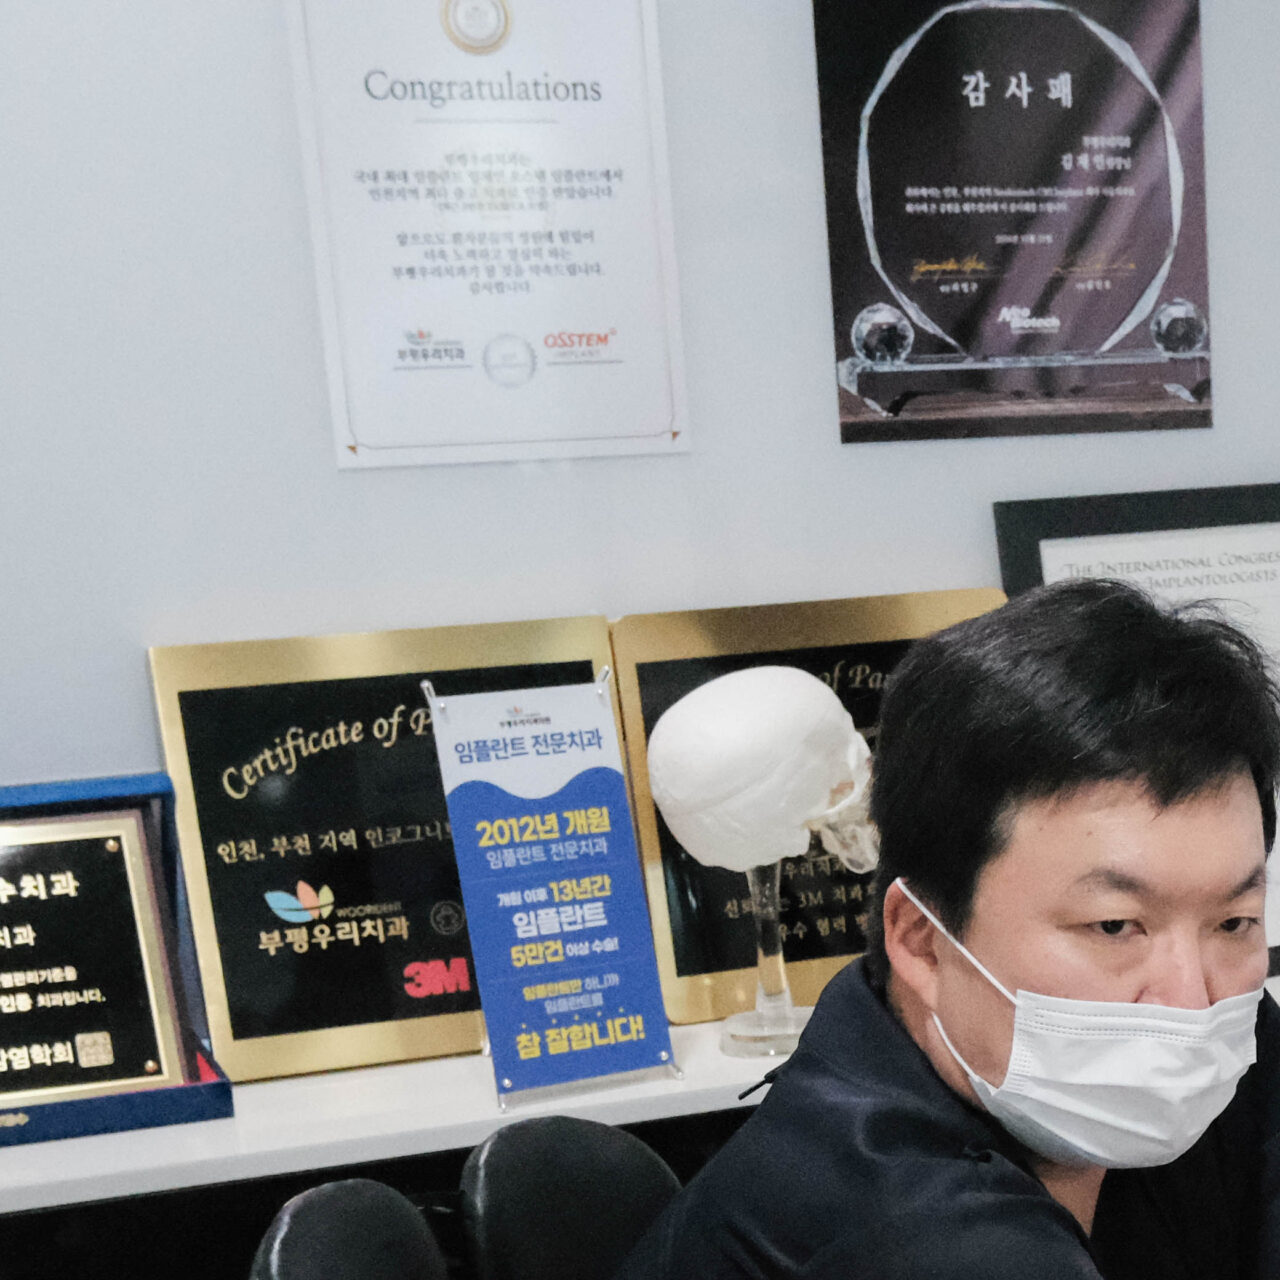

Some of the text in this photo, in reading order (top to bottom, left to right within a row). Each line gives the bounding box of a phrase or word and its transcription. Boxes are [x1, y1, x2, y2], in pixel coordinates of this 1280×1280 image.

[364, 69, 602, 109] Congratulations
[544, 332, 609, 348] OSSTEM
[222, 721, 364, 799] Certificate
[373, 705, 406, 748] of
[454, 728, 603, 764] 임플란트 전문치과
[319, 829, 358, 852] 지역
[365, 822, 452, 849] 인코그니
[475, 806, 612, 847] 2012년 개원
[486, 837, 608, 869] 임플란트 전문치과
[549, 874, 611, 903] 13년간
[258, 915, 410, 957] 부평우리치과
[512, 901, 608, 939] 임플란트
[510, 939, 565, 968] 5만건
[565, 941, 589, 957] 이상
[403, 957, 471, 998] 3M
[516, 1014, 645, 1060] 참 잘합니다!
